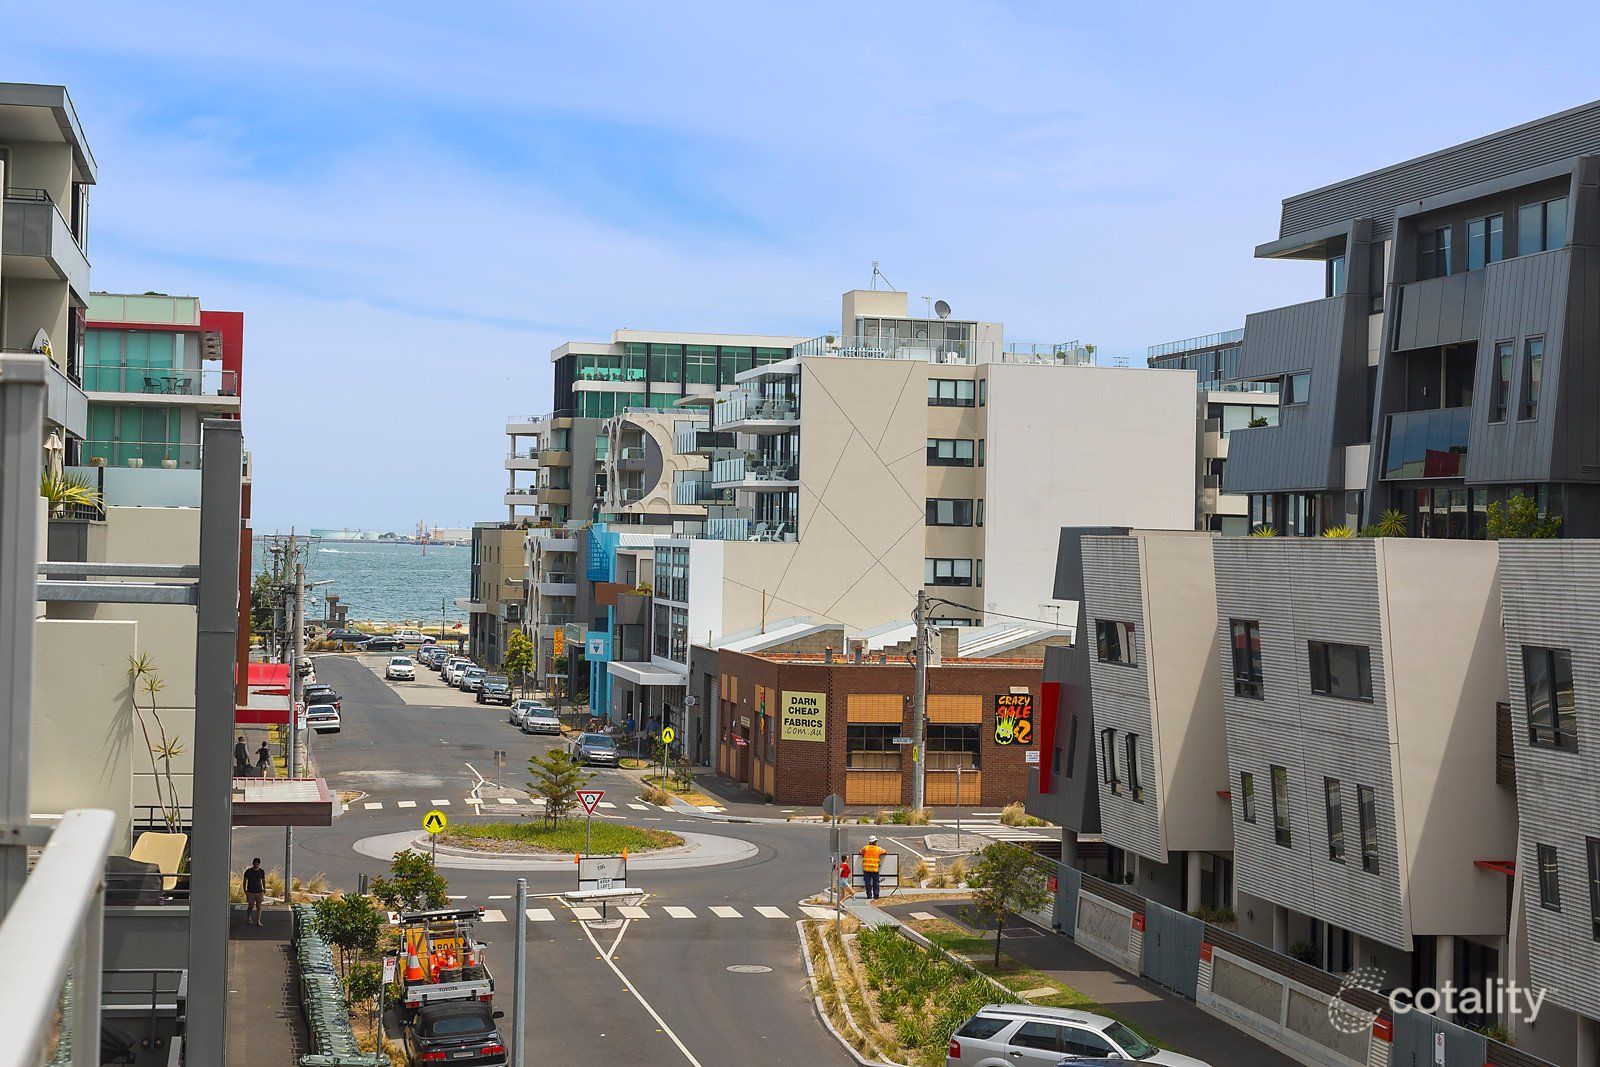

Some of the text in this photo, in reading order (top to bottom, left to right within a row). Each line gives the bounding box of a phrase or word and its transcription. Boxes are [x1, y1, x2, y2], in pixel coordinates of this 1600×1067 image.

[791, 697, 817, 706] DARN
[998, 696, 1031, 706] CRAZY
[788, 707, 820, 716] CHEAP
[997, 705, 1032, 719] SALE
[784, 718, 823, 728] FABRICS
[785, 727, 822, 736] .com.au
